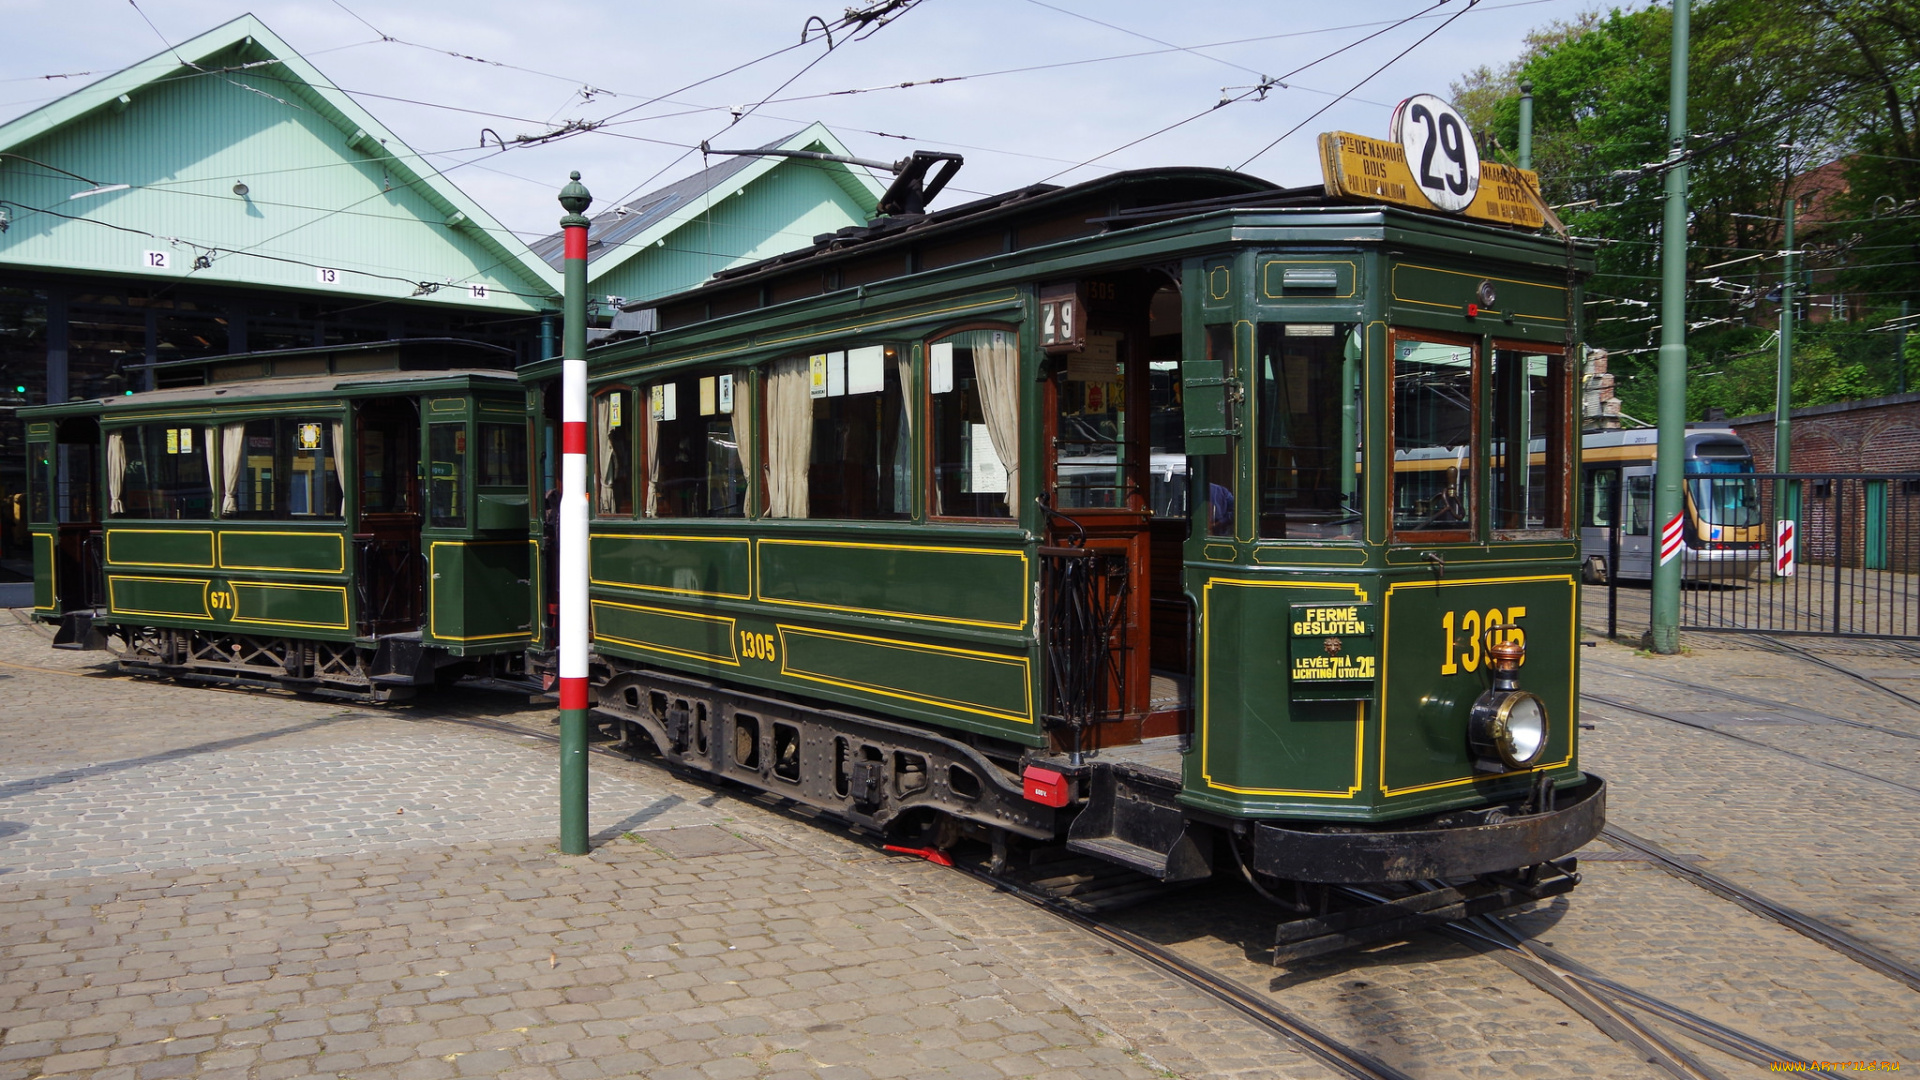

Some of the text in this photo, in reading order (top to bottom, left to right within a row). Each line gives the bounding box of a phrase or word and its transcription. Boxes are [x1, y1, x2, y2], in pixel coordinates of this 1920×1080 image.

[1368, 143, 1403, 163] NAMUR
[1411, 103, 1468, 196] 29
[1363, 159, 1387, 178] BOIS
[1497, 185, 1528, 205] BOSCH
[149, 252, 165, 267] 12
[321, 269, 335, 282] 13
[472, 285, 485, 297] 14
[1044, 302, 1073, 339] 29
[211, 591, 232, 610] 671
[1306, 606, 1358, 622] FERMÉ
[1293, 621, 1365, 635] GESLOTEN
[740, 630, 776, 662] 1305
[1441, 606, 1526, 675] 1305
[1296, 656, 1329, 668] LEVÉE
[1292, 668, 1333, 679] LICHTING
